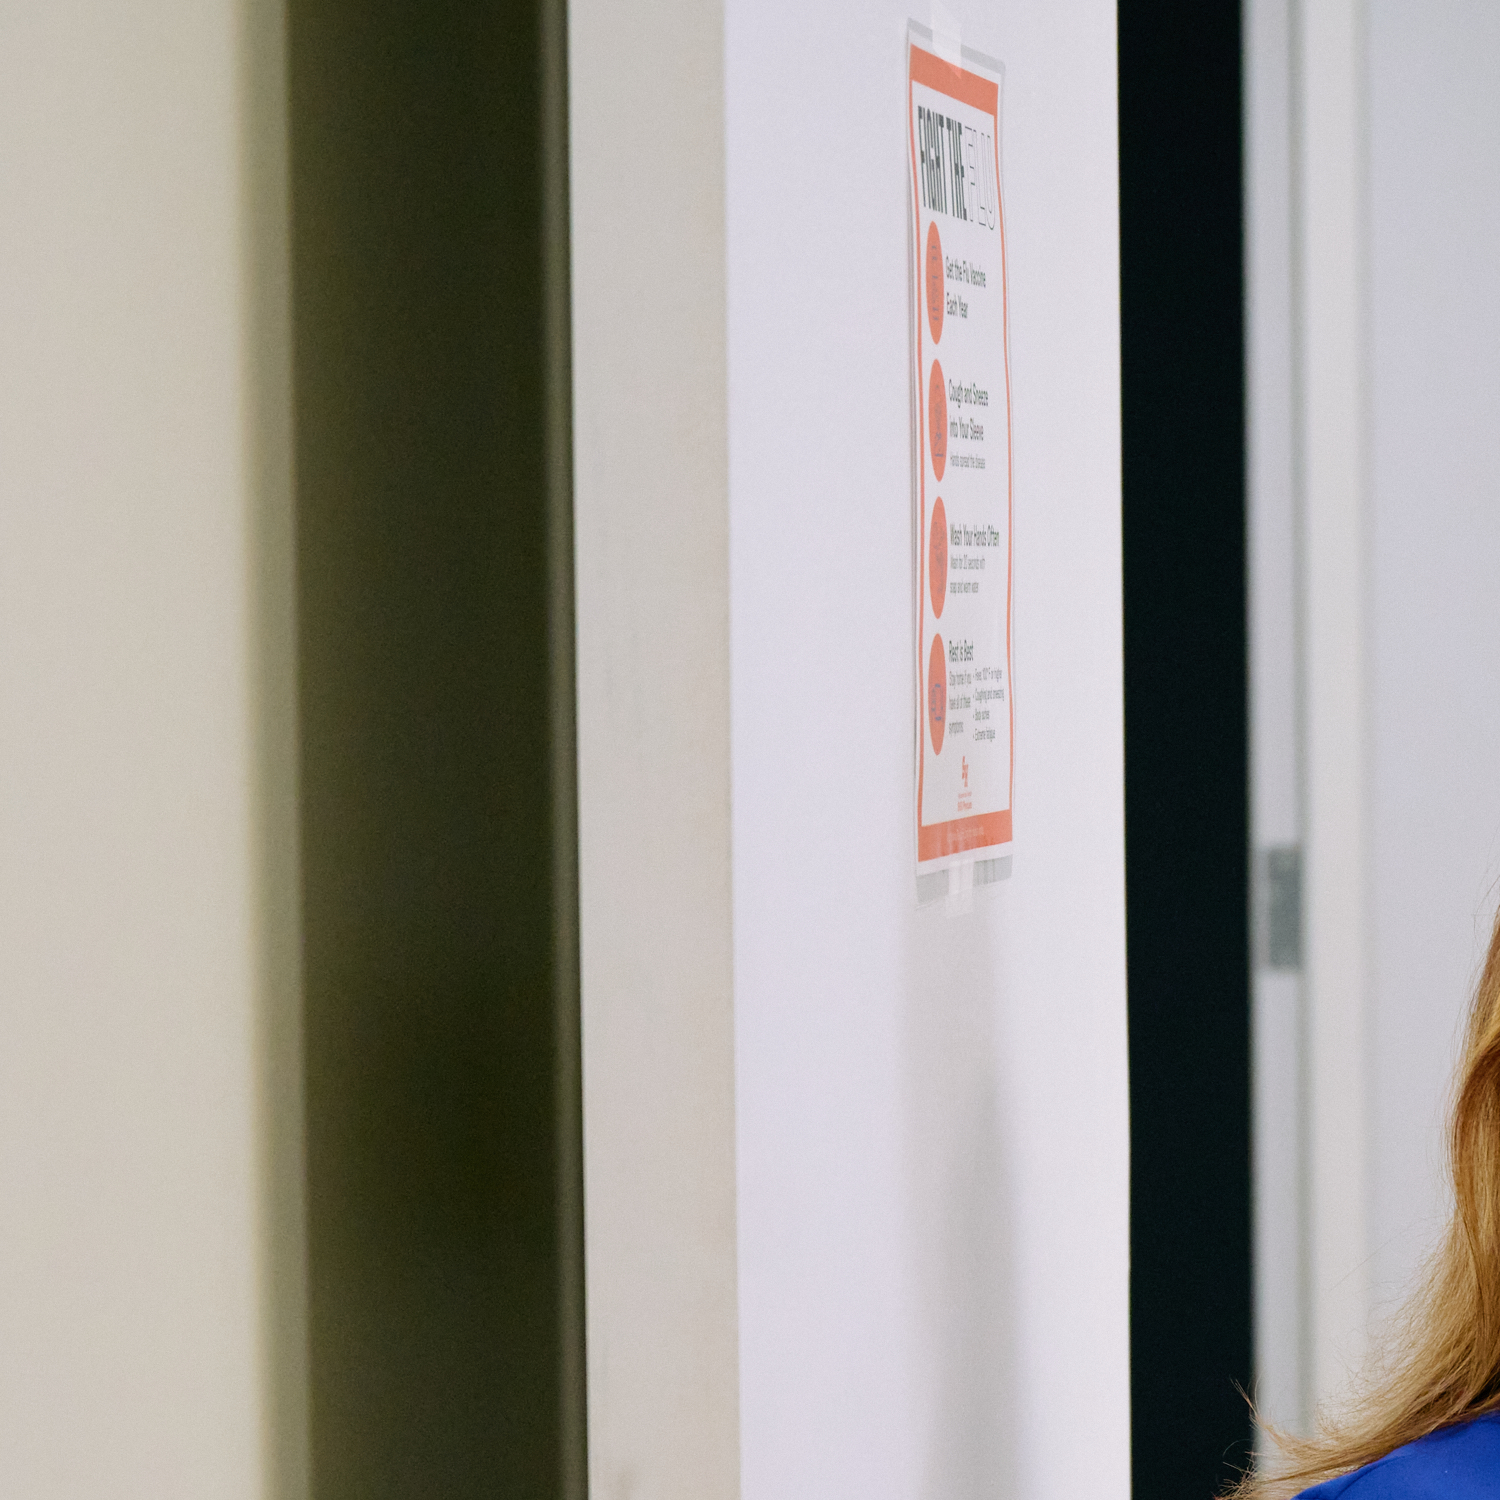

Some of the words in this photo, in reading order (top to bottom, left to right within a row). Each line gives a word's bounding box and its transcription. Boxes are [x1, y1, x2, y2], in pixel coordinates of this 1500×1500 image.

[918, 105, 947, 215] FIGHT
[946, 117, 967, 221] THE
[965, 126, 996, 231] FLU
[949, 378, 963, 408] Cough
[964, 382, 972, 404] and
[949, 640, 959, 662] Rest
[964, 639, 973, 661] Best
